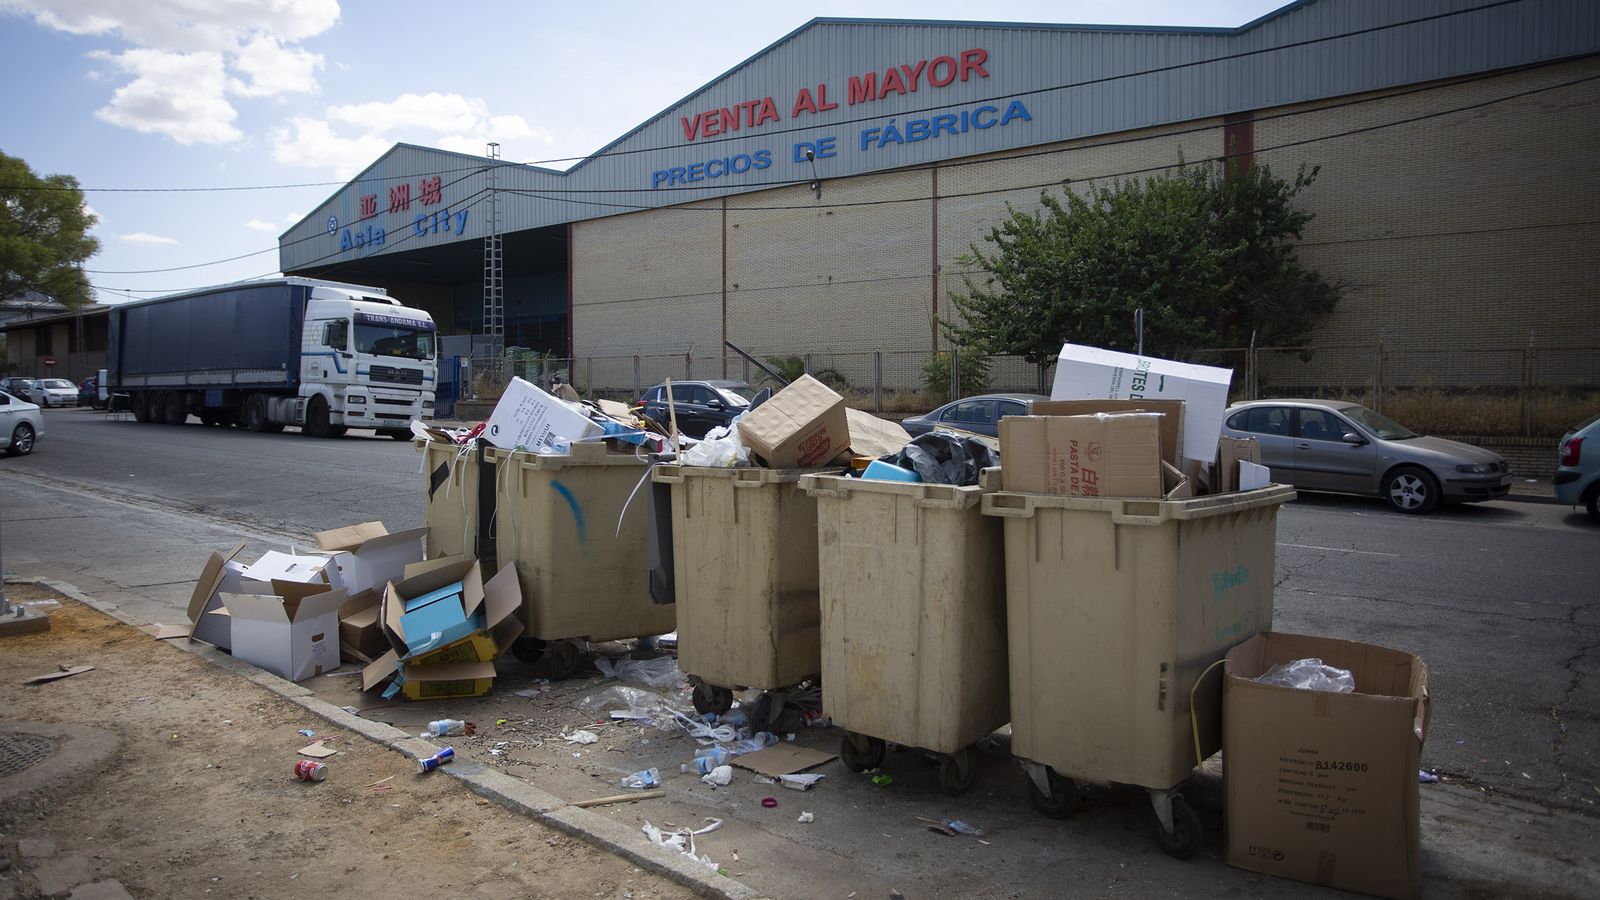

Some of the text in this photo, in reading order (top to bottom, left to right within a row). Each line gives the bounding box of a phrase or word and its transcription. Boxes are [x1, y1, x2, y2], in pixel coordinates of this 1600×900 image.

[681, 47, 989, 141] VENTA AL MAYOR
[652, 100, 1033, 188] PRECIOS DE FÁBRICA
[359, 175, 442, 221] 亚洲城
[340, 208, 469, 251] Asia City
[1070, 439, 1079, 491] PASTA DE
